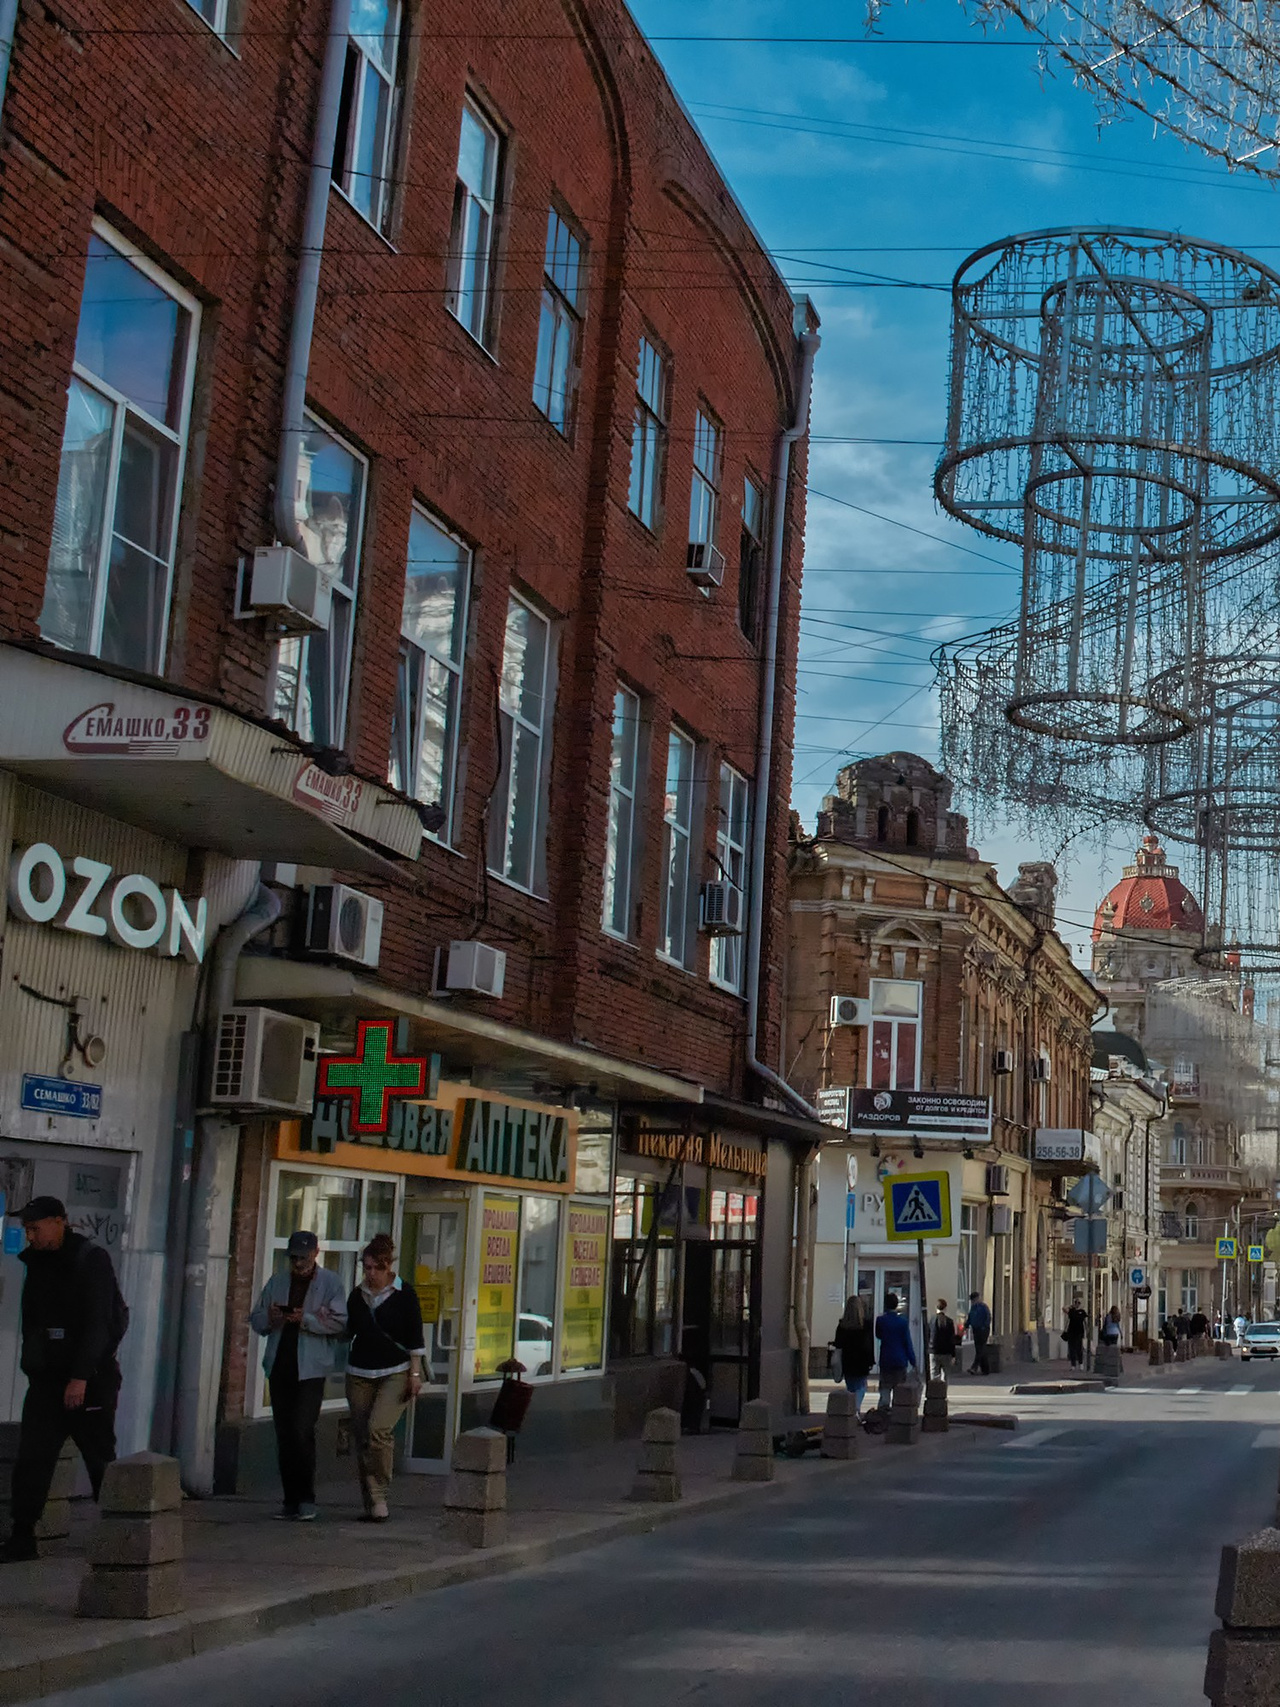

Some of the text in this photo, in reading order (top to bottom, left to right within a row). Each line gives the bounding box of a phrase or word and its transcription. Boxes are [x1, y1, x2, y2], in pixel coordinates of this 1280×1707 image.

[18, 842, 207, 964] OZON
[34, 1088, 76, 1105] СЕМАШКО
[908, 1096, 987, 1108] ЗАКОННО ОСВОБОДИМ
[857, 1112, 901, 1122] РАЗДОРОВ
[466, 1098, 570, 1183] АПТЕКА
[708, 1131, 768, 1177] Мельница
